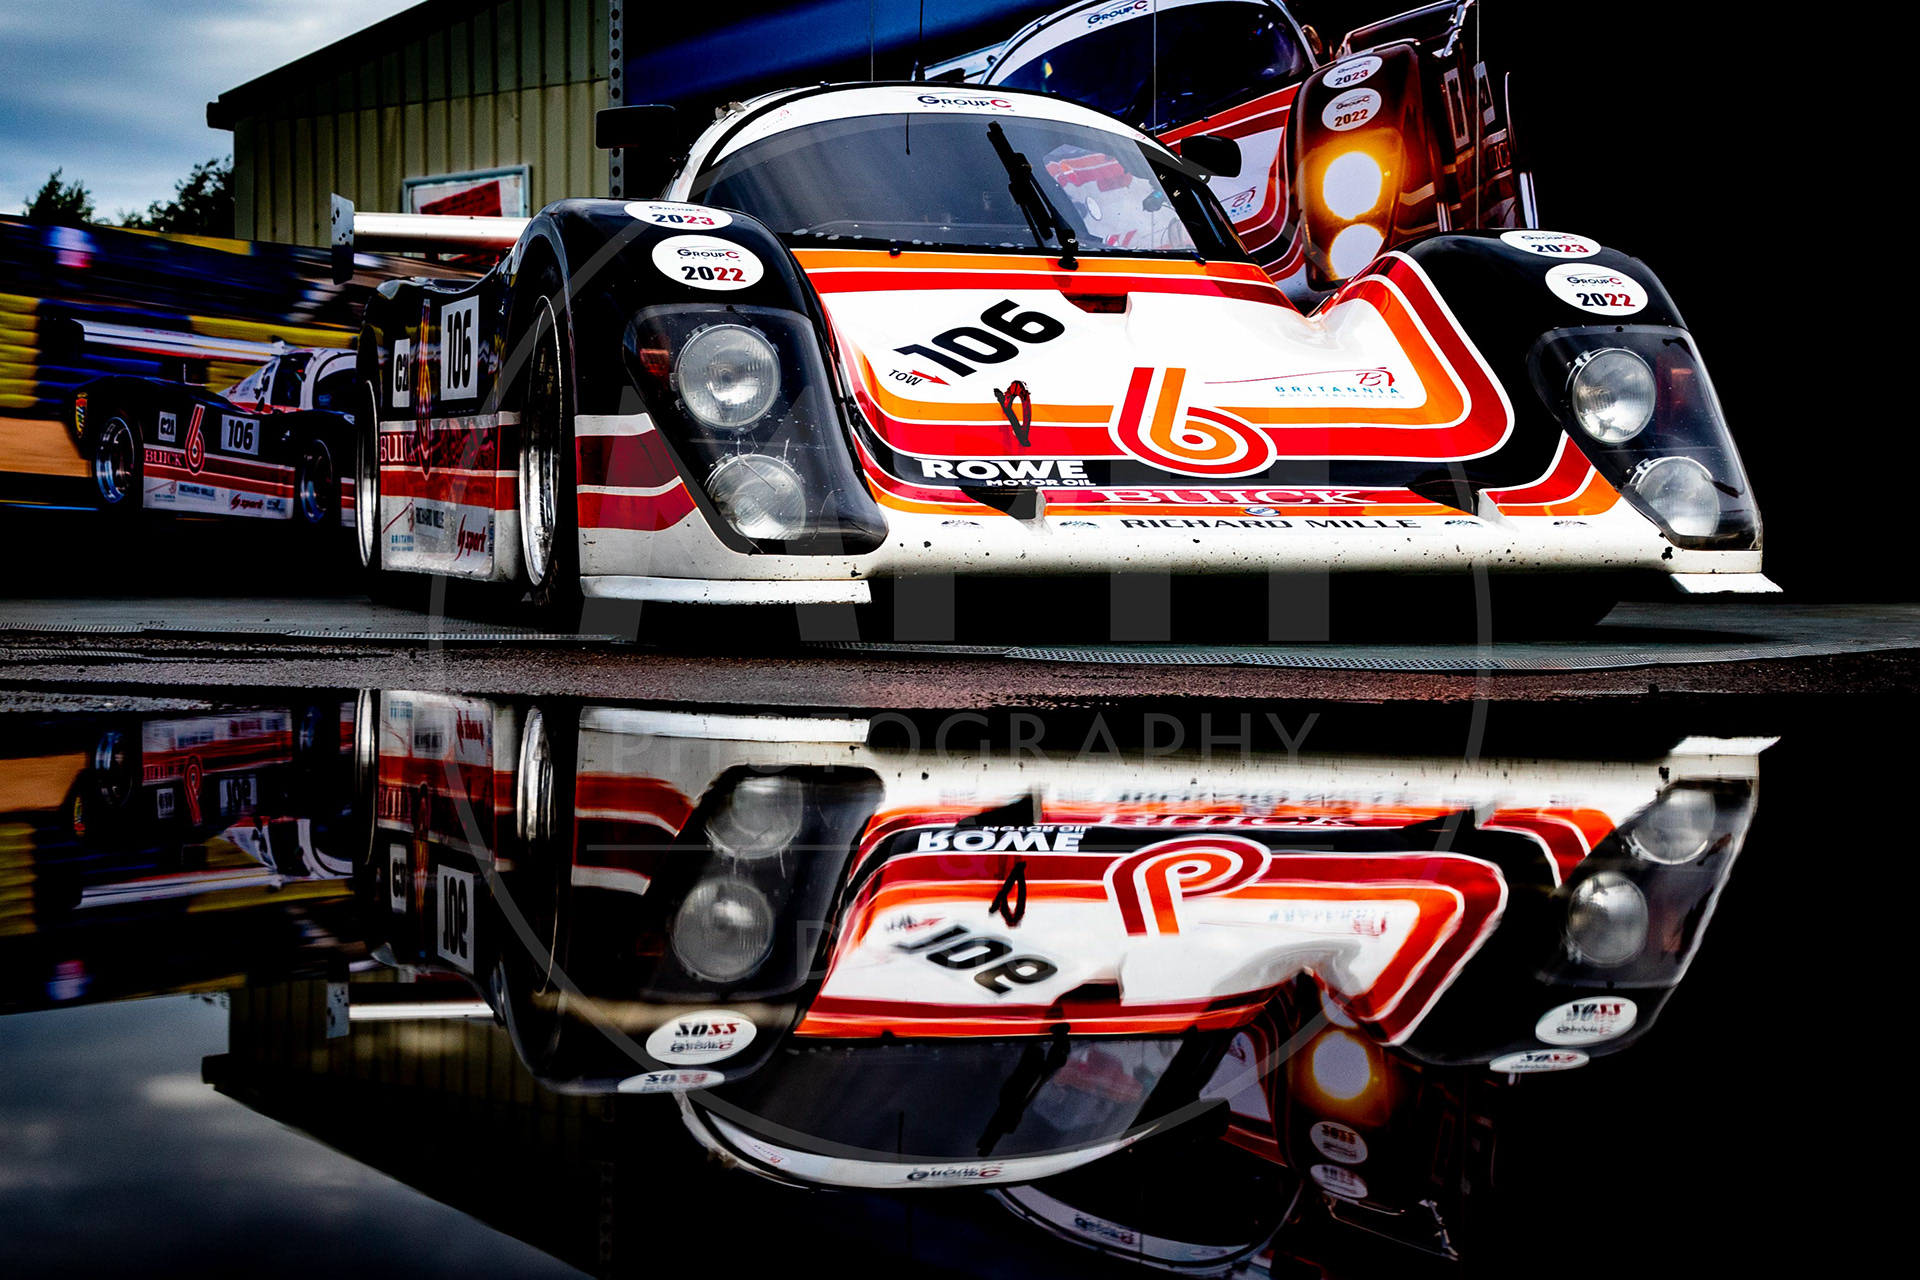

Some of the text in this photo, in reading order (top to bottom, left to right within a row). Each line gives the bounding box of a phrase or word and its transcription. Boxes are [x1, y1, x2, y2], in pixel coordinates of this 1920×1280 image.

[1335, 69, 1368, 86] 2023
[1335, 108, 1368, 127] 2022
[652, 214, 715, 225] 2023
[1531, 244, 1589, 253] 2023
[681, 266, 746, 282] 2022
[1576, 293, 1636, 307] 2022
[893, 299, 1065, 377] 106
[447, 309, 473, 390] 106
[888, 369, 923, 386] TOW
[1275, 386, 1400, 394] BRITANNIA
[228, 419, 253, 451] 106
[144, 450, 183, 467] BUICK
[914, 458, 1090, 480] ROWE
[986, 479, 1096, 487] MOTOR OIL
[1092, 490, 1378, 504] BUICK
[1120, 519, 1422, 530] RICHARD MILLE
